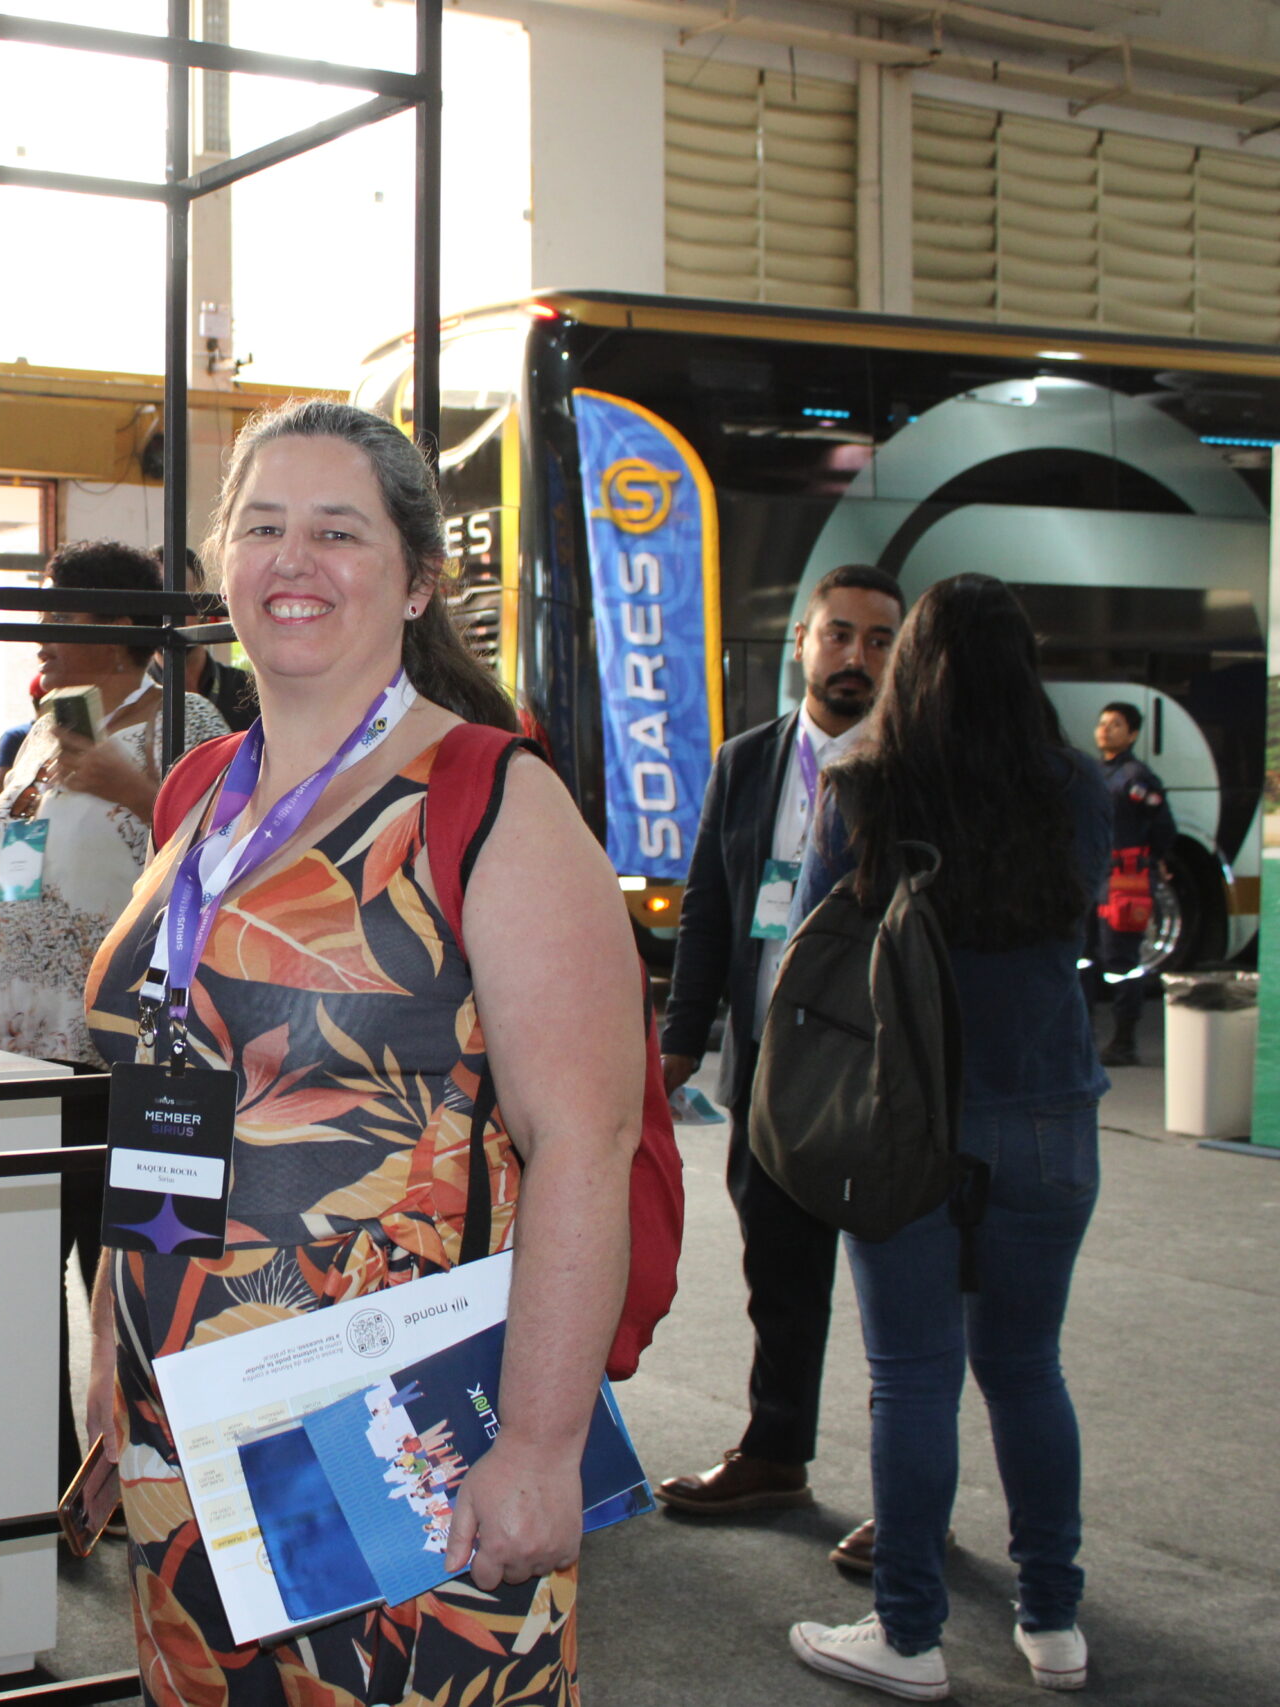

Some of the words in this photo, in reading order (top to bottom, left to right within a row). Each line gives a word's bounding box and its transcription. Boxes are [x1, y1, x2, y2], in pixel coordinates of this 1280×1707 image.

[619, 551, 682, 861] SOARES
[144, 1110, 202, 1125] MEMBER
[152, 1123, 194, 1137] SIRIUS
[136, 1163, 168, 1175] RAQUEL
[170, 1166, 198, 1177] ROCHA
[404, 1303, 448, 1325] monde
